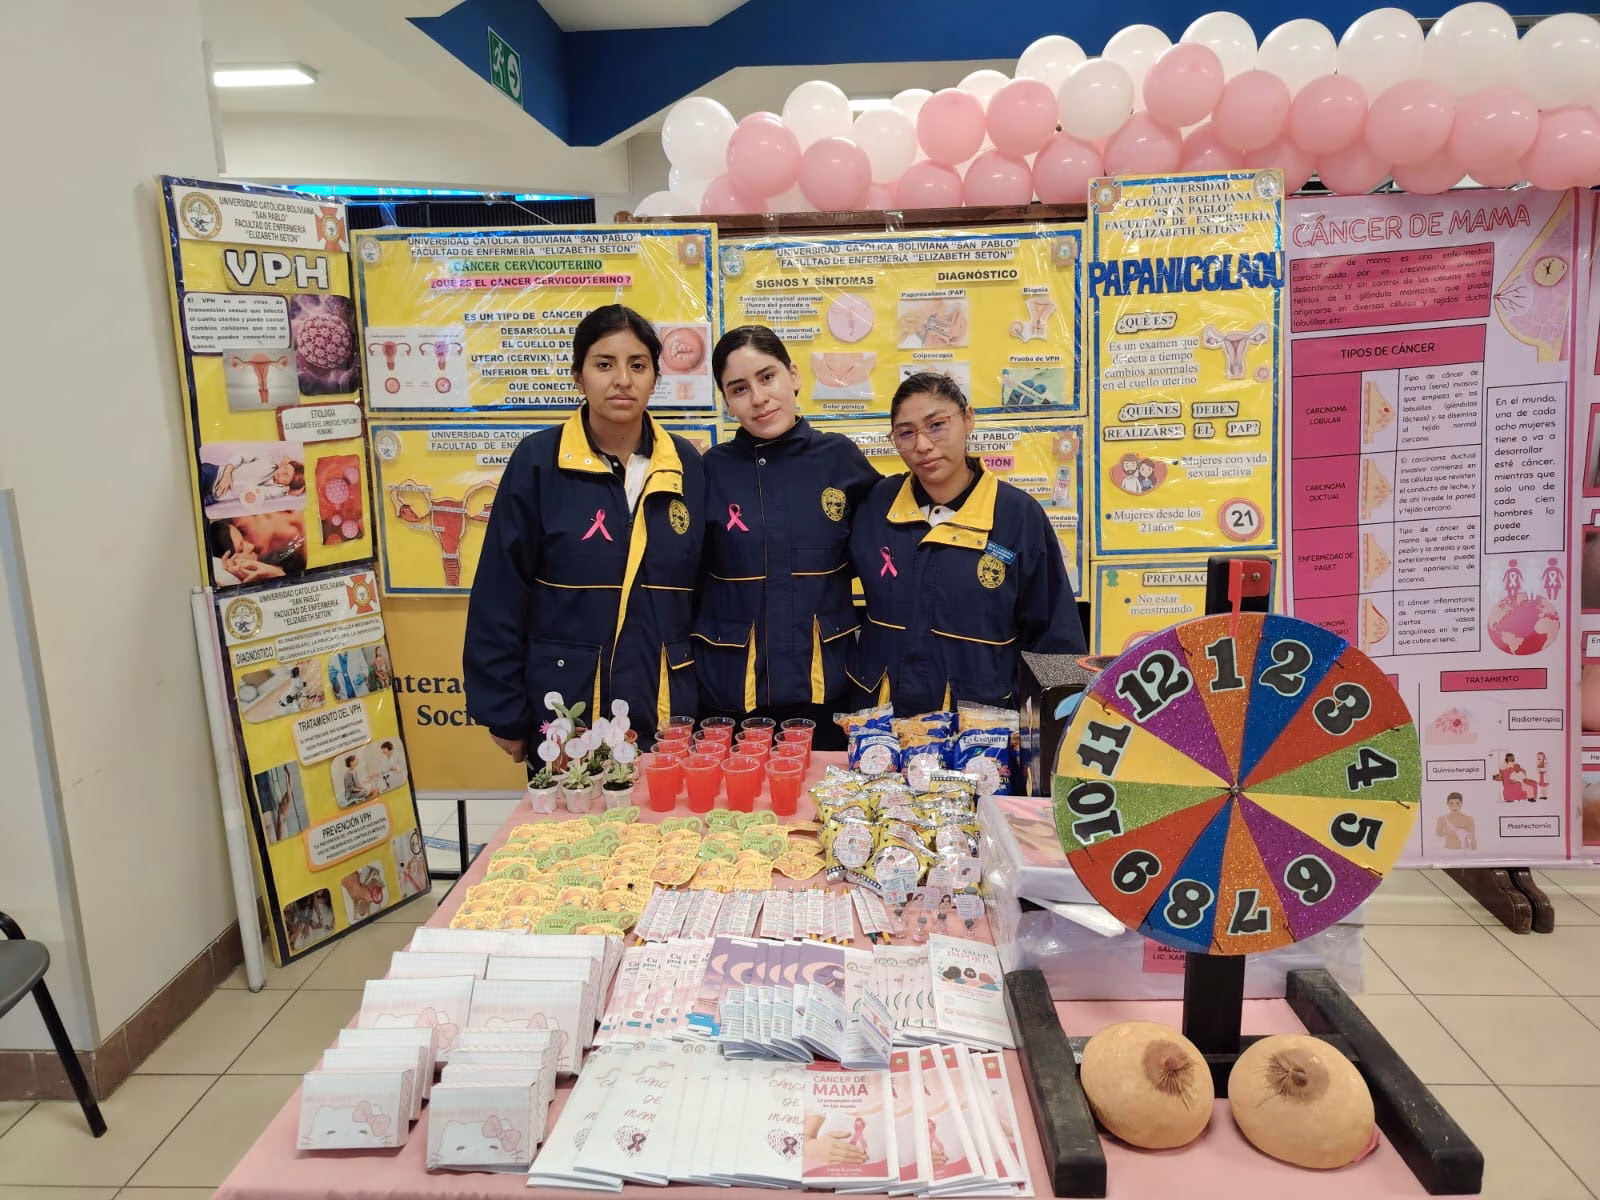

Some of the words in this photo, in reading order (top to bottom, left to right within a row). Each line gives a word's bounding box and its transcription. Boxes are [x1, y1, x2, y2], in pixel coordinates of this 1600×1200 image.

[1152, 182, 1230, 195] UNIVERSIDAD
[1189, 192, 1252, 203] BOLIVIANA
[1292, 214, 1402, 248] CÁNCER
[1408, 213, 1444, 238] DE
[1448, 204, 1528, 234] MAMA
[408, 238, 469, 246] UNIVERSIDAD
[522, 235, 572, 243] BOLIVIANA
[412, 248, 458, 256] FACULTAD
[224, 249, 329, 289] VPH
[454, 260, 500, 272] CÁNCER
[938, 270, 1018, 280] DIAGNÓSTICO
[1088, 250, 1284, 298] PAPANICOLAOU
[490, 278, 531, 286] CÁNCER
[756, 279, 798, 288] SIGNOS
[802, 278, 808, 287] Y
[816, 276, 874, 286] SÍNTOMAS
[1120, 314, 1149, 329] ¿QUÉ
[1154, 316, 1173, 326] ES?
[1109, 342, 1120, 351] Es
[1140, 341, 1177, 350] examen
[1182, 339, 1199, 349] que
[1341, 347, 1372, 359] TIPOS
[1374, 346, 1388, 356] DE
[1392, 342, 1434, 354] CÁNCER
[1159, 352, 1192, 362] tiempo
[1104, 368, 1144, 378] cambios
[1148, 364, 1199, 375] anormales
[1118, 380, 1126, 388] el
[1129, 378, 1158, 388] cuello
[1162, 376, 1196, 386] uterino
[1496, 398, 1506, 406] En
[1121, 404, 1178, 418] ¿QUIÉNES
[1196, 404, 1236, 415] DEBEN
[1306, 405, 1347, 415] CARCINOMA
[1532, 407, 1556, 415] cada
[1310, 416, 1341, 425] LOBULAR
[1496, 423, 1516, 431] ocho
[1518, 421, 1556, 430] mujeres
[1108, 426, 1182, 438] REALIZARSE
[1197, 426, 1212, 435] EL
[1230, 423, 1258, 433] PAP?
[1494, 446, 1542, 456] desarrollar
[1247, 454, 1268, 464] vida
[1188, 468, 1218, 478] sexual
[1222, 467, 1252, 477] activa
[1494, 472, 1534, 481] mientras
[1537, 471, 1556, 480] que
[1306, 482, 1346, 492] CARCINOMA
[1494, 485, 1512, 494] solo
[1543, 482, 1555, 490] de
[1310, 494, 1340, 502] DUCTUAL
[1494, 497, 1516, 506] cada
[1535, 495, 1554, 504] cien
[1114, 511, 1151, 522] Mujeres
[1156, 510, 1184, 520] desde
[1187, 509, 1201, 518] los
[1494, 510, 1533, 518] hombres
[1546, 507, 1554, 515] lo
[1232, 510, 1254, 528] 21
[1494, 522, 1520, 531] puede
[1298, 553, 1344, 562] ENFERMEDAD
[1314, 564, 1336, 572] PAGET
[1146, 574, 1208, 584] PREPARAC
[1138, 596, 1152, 604] No
[1130, 605, 1192, 616] menstruando
[1205, 637, 1245, 692] 1
[1260, 640, 1313, 697] 2
[393, 675, 466, 694] ntera
[1466, 675, 1520, 684] TRATAMIENTO
[1116, 650, 1193, 722] 12
[417, 704, 473, 726] Soci
[1312, 683, 1372, 735] 3
[298, 713, 338, 732] TRATAMIENTO
[338, 708, 350, 720] DEL
[350, 704, 362, 715] VPH
[1511, 716, 1560, 724] Radioterapia
[1076, 721, 1132, 777] 11
[1346, 747, 1398, 792] 4
[1067, 781, 1122, 845] 10
[322, 816, 358, 839] PREVENCIÓN
[360, 811, 372, 824] VPH
[1330, 812, 1384, 850] 5
[1112, 850, 1162, 894] 9
[1284, 855, 1336, 906] 6
[1164, 879, 1214, 929] 8
[1228, 889, 1270, 935] 7
[948, 952, 992, 964] IMPORTA
[854, 1074, 867, 1082] DE
[812, 1083, 869, 1096] MAMA
